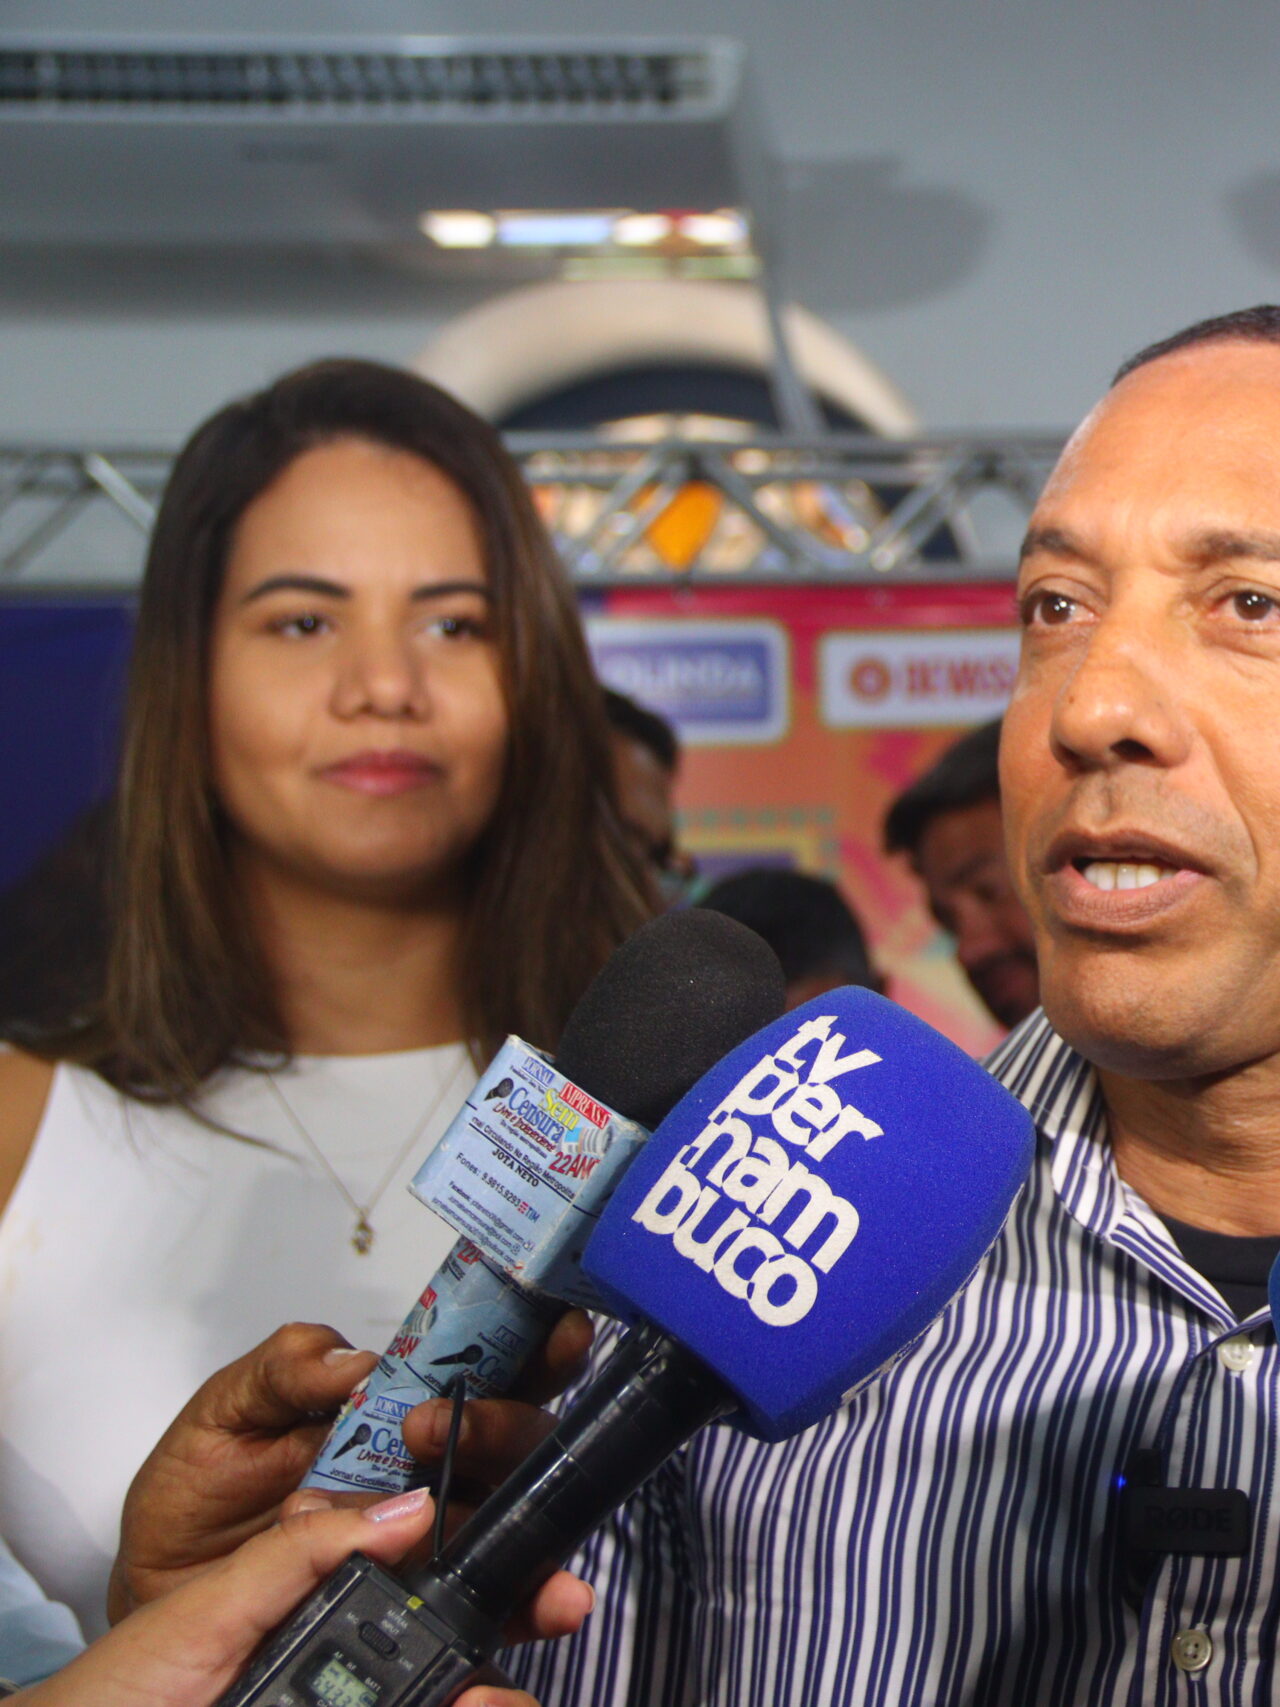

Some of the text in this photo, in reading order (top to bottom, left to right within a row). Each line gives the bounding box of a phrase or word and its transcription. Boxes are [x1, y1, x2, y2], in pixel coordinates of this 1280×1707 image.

[508, 1087, 565, 1143] Censura
[544, 1088, 580, 1131] Sem
[708, 1054, 885, 1162] per
[491, 1147, 540, 1188] JOTA NETO
[683, 1117, 860, 1275] nam
[631, 1145, 818, 1327] buco
[375, 1396, 412, 1418] JORNA
[330, 1467, 354, 1481] Jornal
